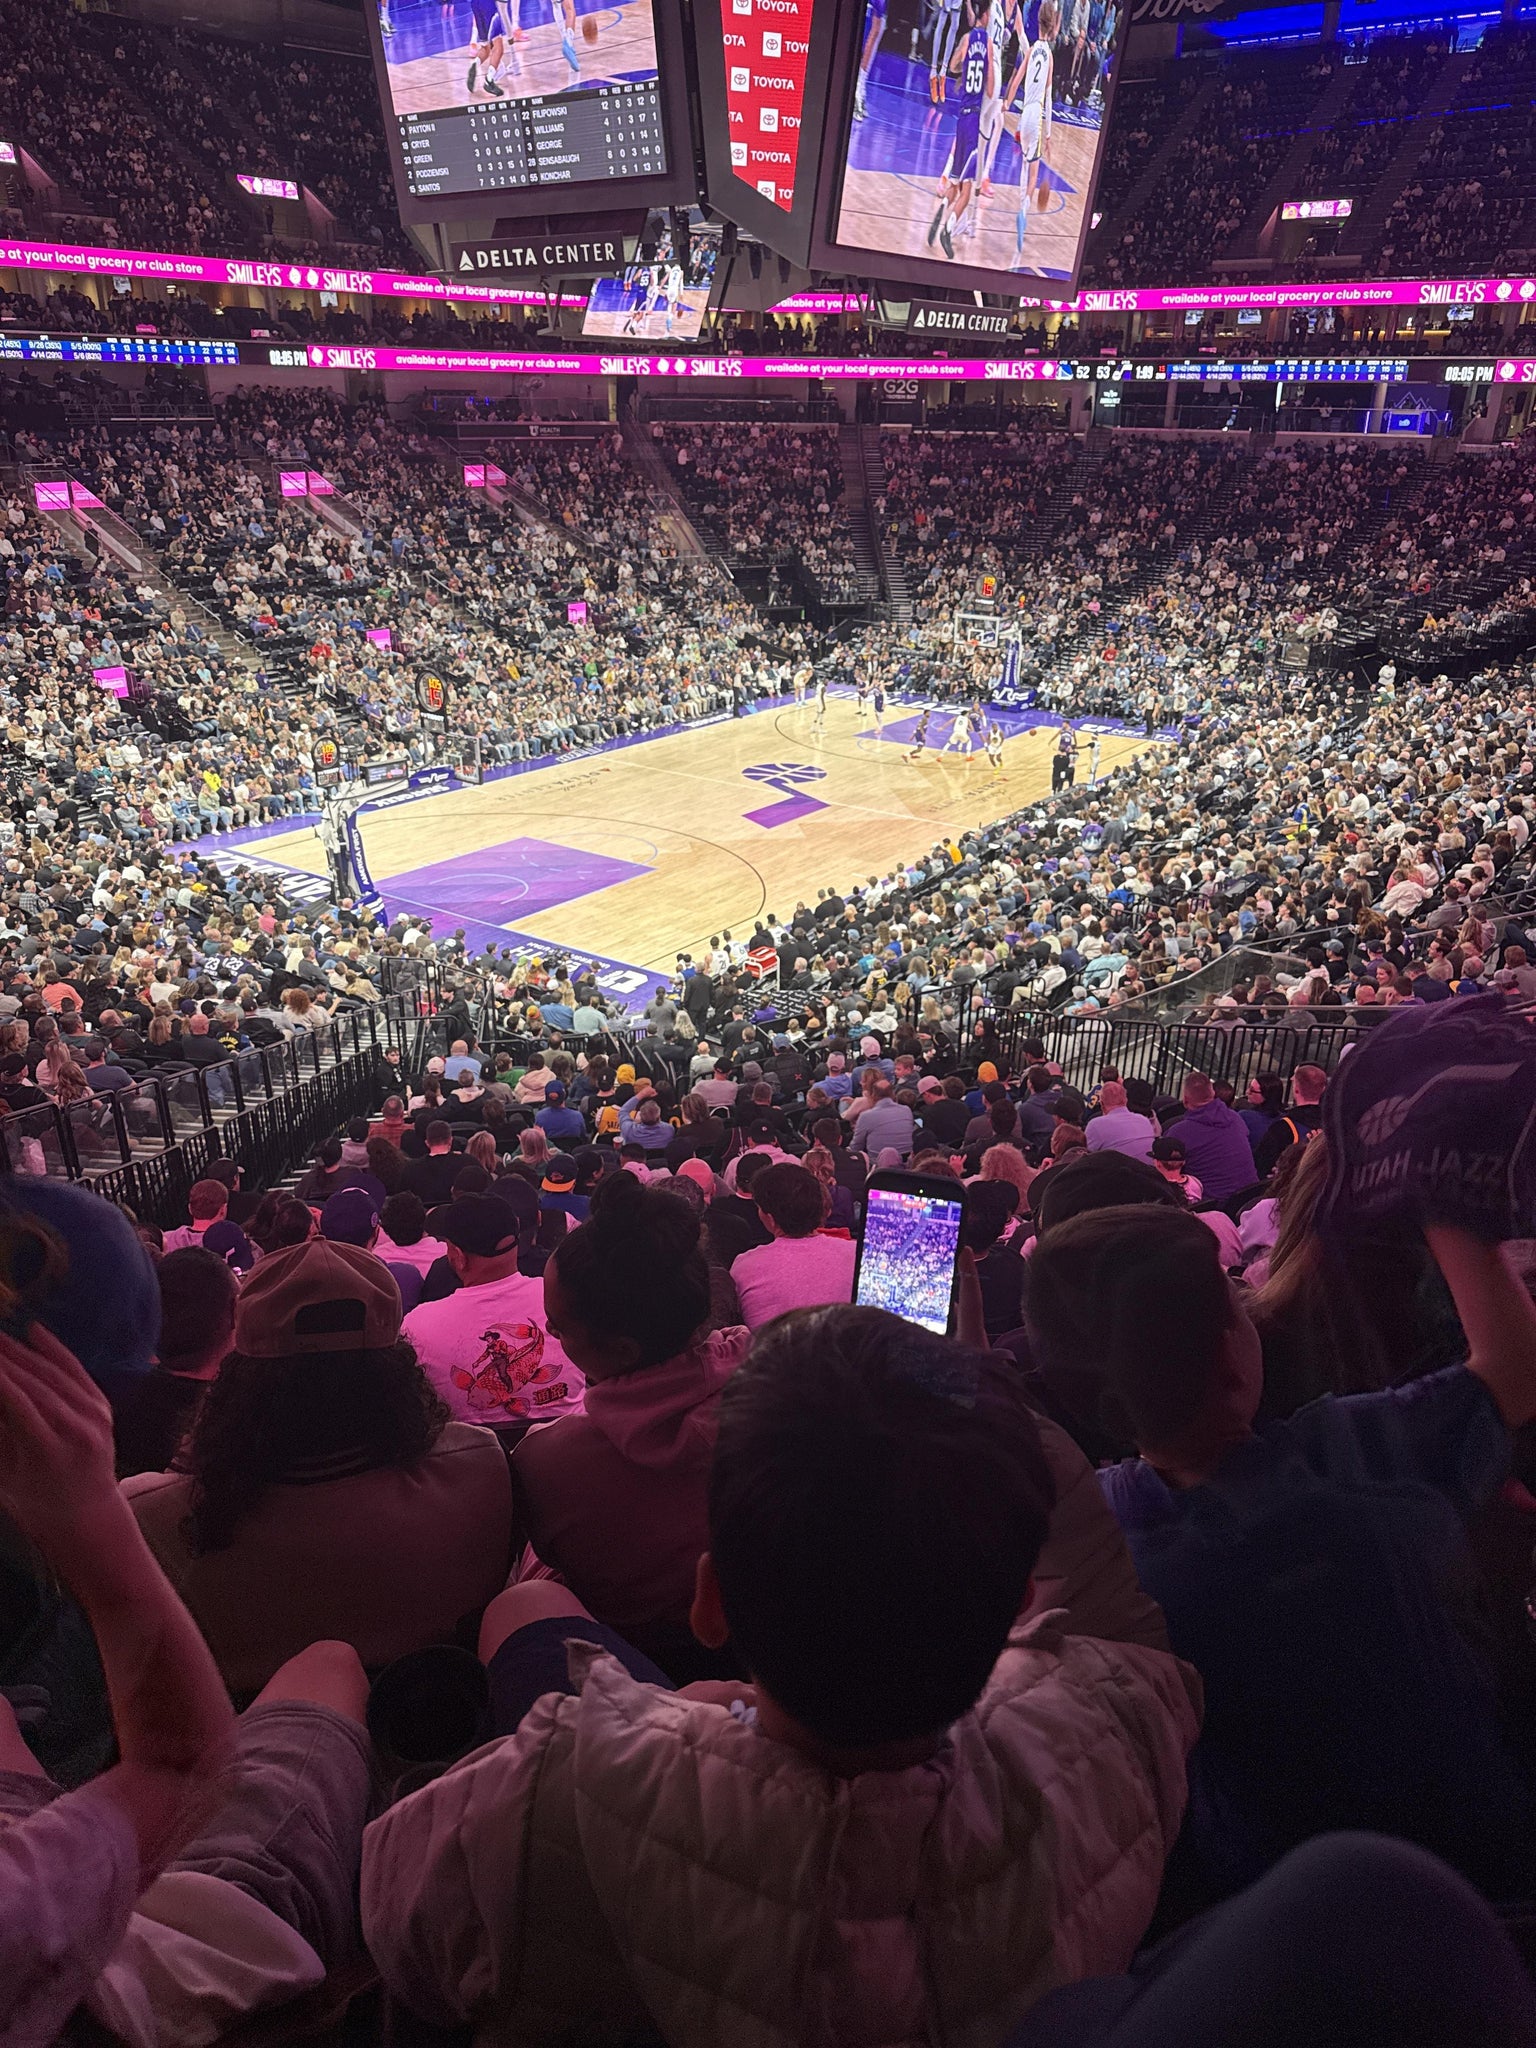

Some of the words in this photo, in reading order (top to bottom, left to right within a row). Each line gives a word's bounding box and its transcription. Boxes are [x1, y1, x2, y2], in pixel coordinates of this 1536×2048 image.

[756, 0, 799, 14] TOYOTA
[966, 60, 984, 93] 55
[1033, 61, 1042, 83] 2
[753, 76, 795, 90] TOYOTA
[521, 111, 530, 120] 22
[532, 106, 568, 119] FILIPOWSKI
[601, 101, 609, 110] 12
[637, 97, 645, 106] 12
[408, 124, 431, 135] PAYTON
[502, 115, 508, 123] 11
[534, 123, 564, 134] WILLIAMS
[639, 113, 646, 122] 17
[411, 140, 431, 149] CRYER
[503, 130, 511, 138] 07
[536, 139, 563, 150] GEORGE
[413, 154, 433, 163] GREEN
[507, 160, 515, 169] 15
[751, 150, 791, 164] TOYOTA
[530, 173, 538, 182] 55
[643, 162, 651, 171] 13
[409, 185, 416, 194] 15
[418, 183, 441, 192] SANTOS
[8, 248, 22, 260] at
[25, 251, 53, 264] your
[55, 251, 86, 265] local
[88, 256, 133, 272] grocery
[135, 260, 147, 269] or
[149, 260, 173, 272] club
[175, 263, 203, 274] store
[477, 248, 537, 269] DELTA
[543, 242, 616, 265] CENTER
[393, 281, 433, 293] available
[435, 285, 445, 294] at
[445, 286, 465, 298] your
[465, 286, 487, 297] local
[489, 288, 523, 301] grocery
[1162, 293, 1209, 304] available
[1211, 294, 1222, 303] at
[1224, 294, 1248, 305] your
[1250, 291, 1276, 302] local
[1278, 292, 1320, 305] grocery
[1322, 291, 1334, 300] or
[1336, 289, 1360, 300] club
[1362, 290, 1393, 300] store
[815, 299, 826, 308] at
[927, 310, 965, 329] DELTA
[968, 315, 1008, 333] CENTER
[293, 351, 308, 366] PM
[396, 354, 435, 365] available
[437, 356, 446, 365] at
[448, 357, 466, 368] your
[467, 356, 489, 367] local
[490, 358, 524, 370] grocery
[525, 360, 534, 368] or
[535, 358, 555, 369] club
[556, 360, 580, 369] store
[765, 363, 808, 374] available
[810, 364, 820, 374] at
[822, 365, 843, 375] your
[845, 363, 868, 374] local
[869, 366, 905, 376] grocery
[906, 366, 917, 374] or
[918, 365, 939, 374] club
[939, 364, 965, 375] store
[1076, 365, 1091, 379] 52
[1096, 365, 1111, 379] 53
[1135, 365, 1154, 379] 1:09
[1445, 366, 1475, 382] 08:05
[1475, 366, 1494, 382] PM
[883, 379, 919, 394] G2G
[983, 584, 993, 597] 15
[430, 688, 442, 708] 15
[323, 752, 333, 764] 15
[355, 851, 370, 885] AMERICA
